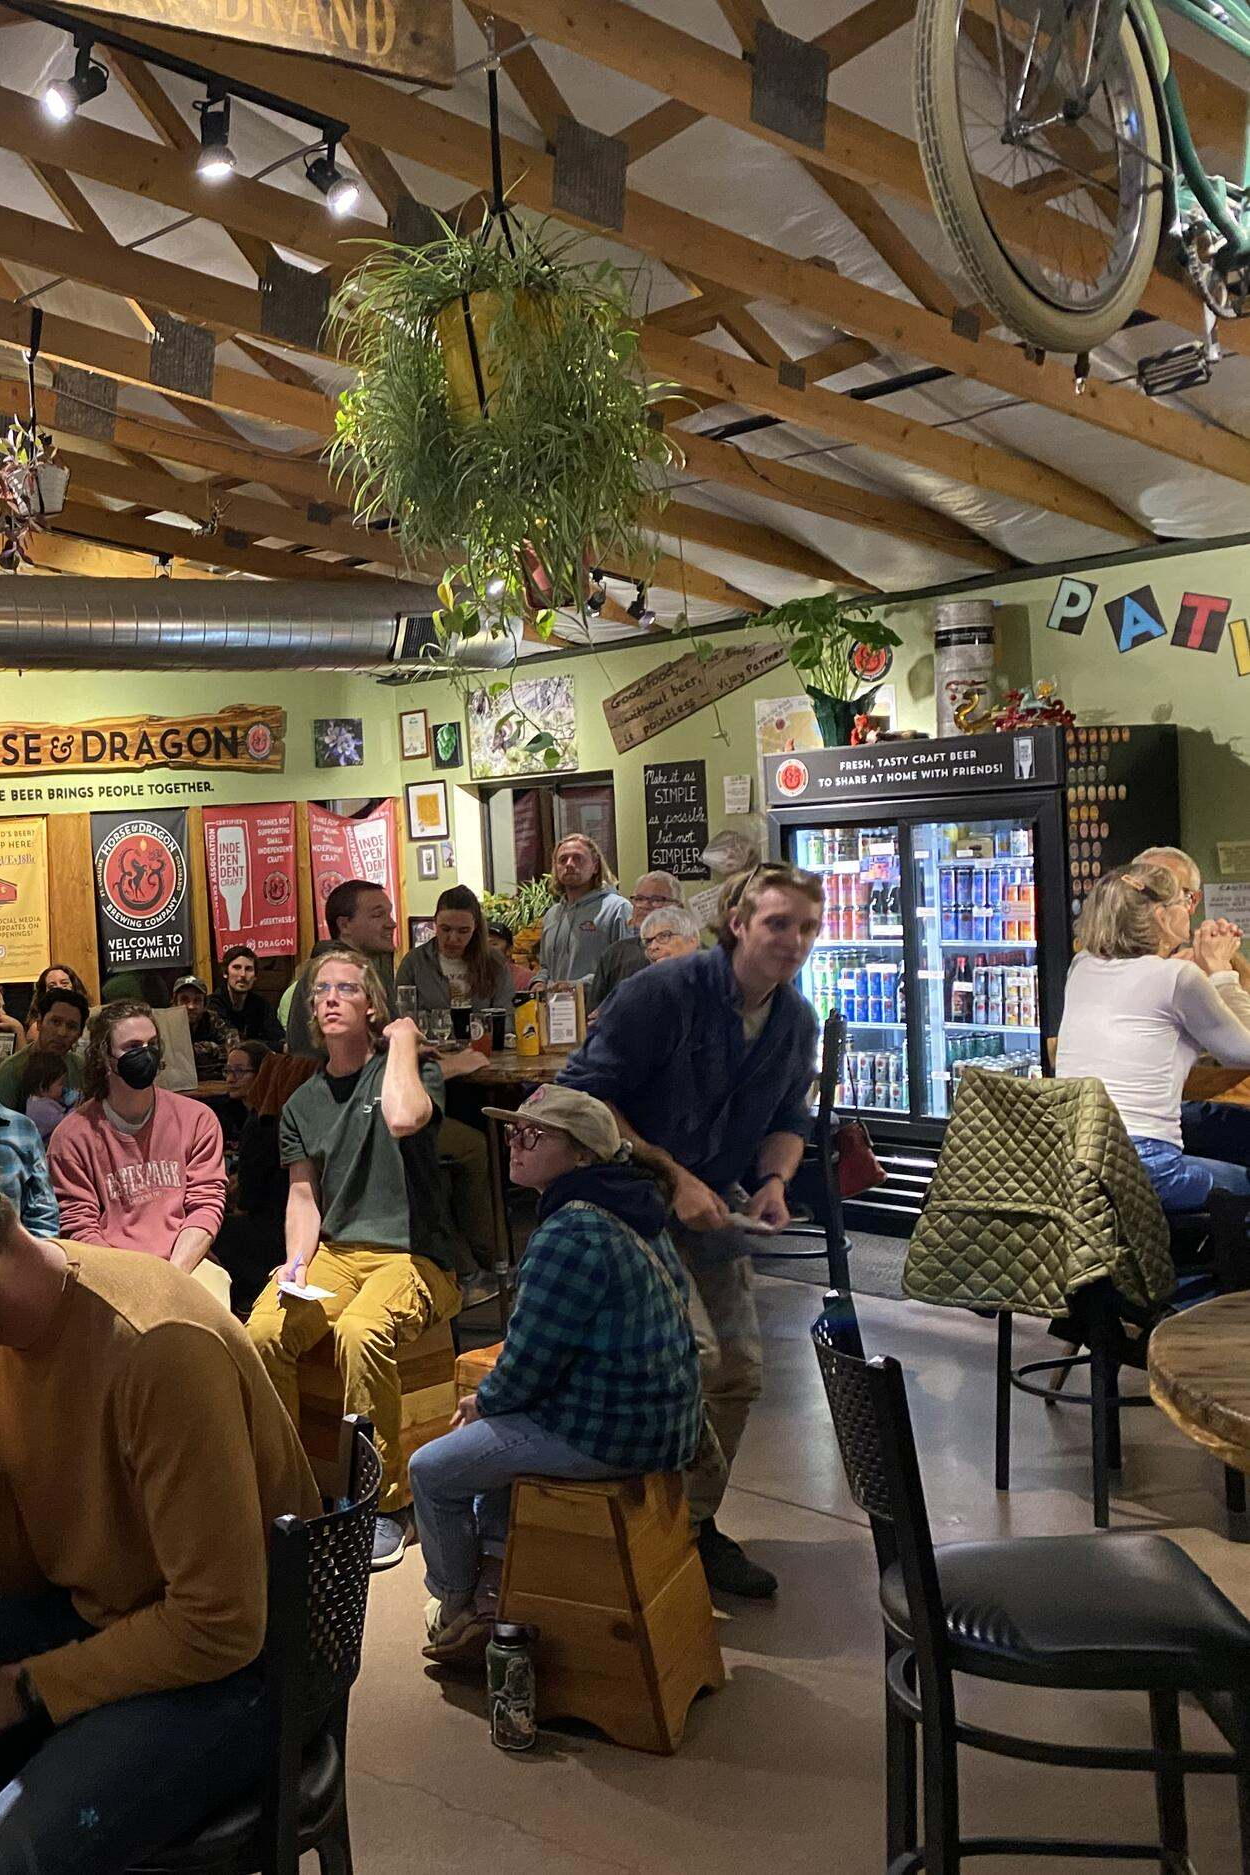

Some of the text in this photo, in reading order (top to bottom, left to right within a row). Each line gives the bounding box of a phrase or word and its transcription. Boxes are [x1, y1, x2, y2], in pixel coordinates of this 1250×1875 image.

[611, 687, 643, 709] Good
[623, 694, 667, 723] without
[624, 698, 696, 744] is pointless
[50, 734, 75, 764] &
[81, 726, 239, 763] DRAGON
[839, 750, 978, 771] FRESH, TASTY CRAFT BEER
[645, 770, 696, 785] Make it as
[818, 764, 1004, 788] TO SHARE AT HOME WITH FRIENDS!
[10, 787, 43, 801] BEER
[47, 786, 94, 800] BRINGS
[99, 784, 144, 797] PEOPLE
[148, 781, 215, 795] TOGETHER.
[655, 785, 697, 804] SIMPLE
[256, 818, 278, 826] THANKS
[257, 827, 290, 836] SUPPORTING
[675, 832, 696, 844] not
[219, 842, 241, 854] INDE
[257, 845, 294, 855] INDEPENDENT
[358, 834, 384, 850] INDE
[208, 828, 218, 882] ASSOCIATION
[219, 854, 239, 866] PEN
[361, 847, 383, 860] PEN
[652, 847, 700, 865] SIMPLER
[220, 866, 244, 878] DENT
[365, 859, 385, 872] DENT
[220, 878, 244, 887] CRAFT
[106, 903, 143, 929] BREWING
[144, 896, 179, 928] COMPANY
[108, 934, 183, 951] WELCOME TO
[257, 938, 294, 949] DRAGON
[109, 946, 180, 962] THE FAMILY!
[146, 1160, 181, 1188] PARK
